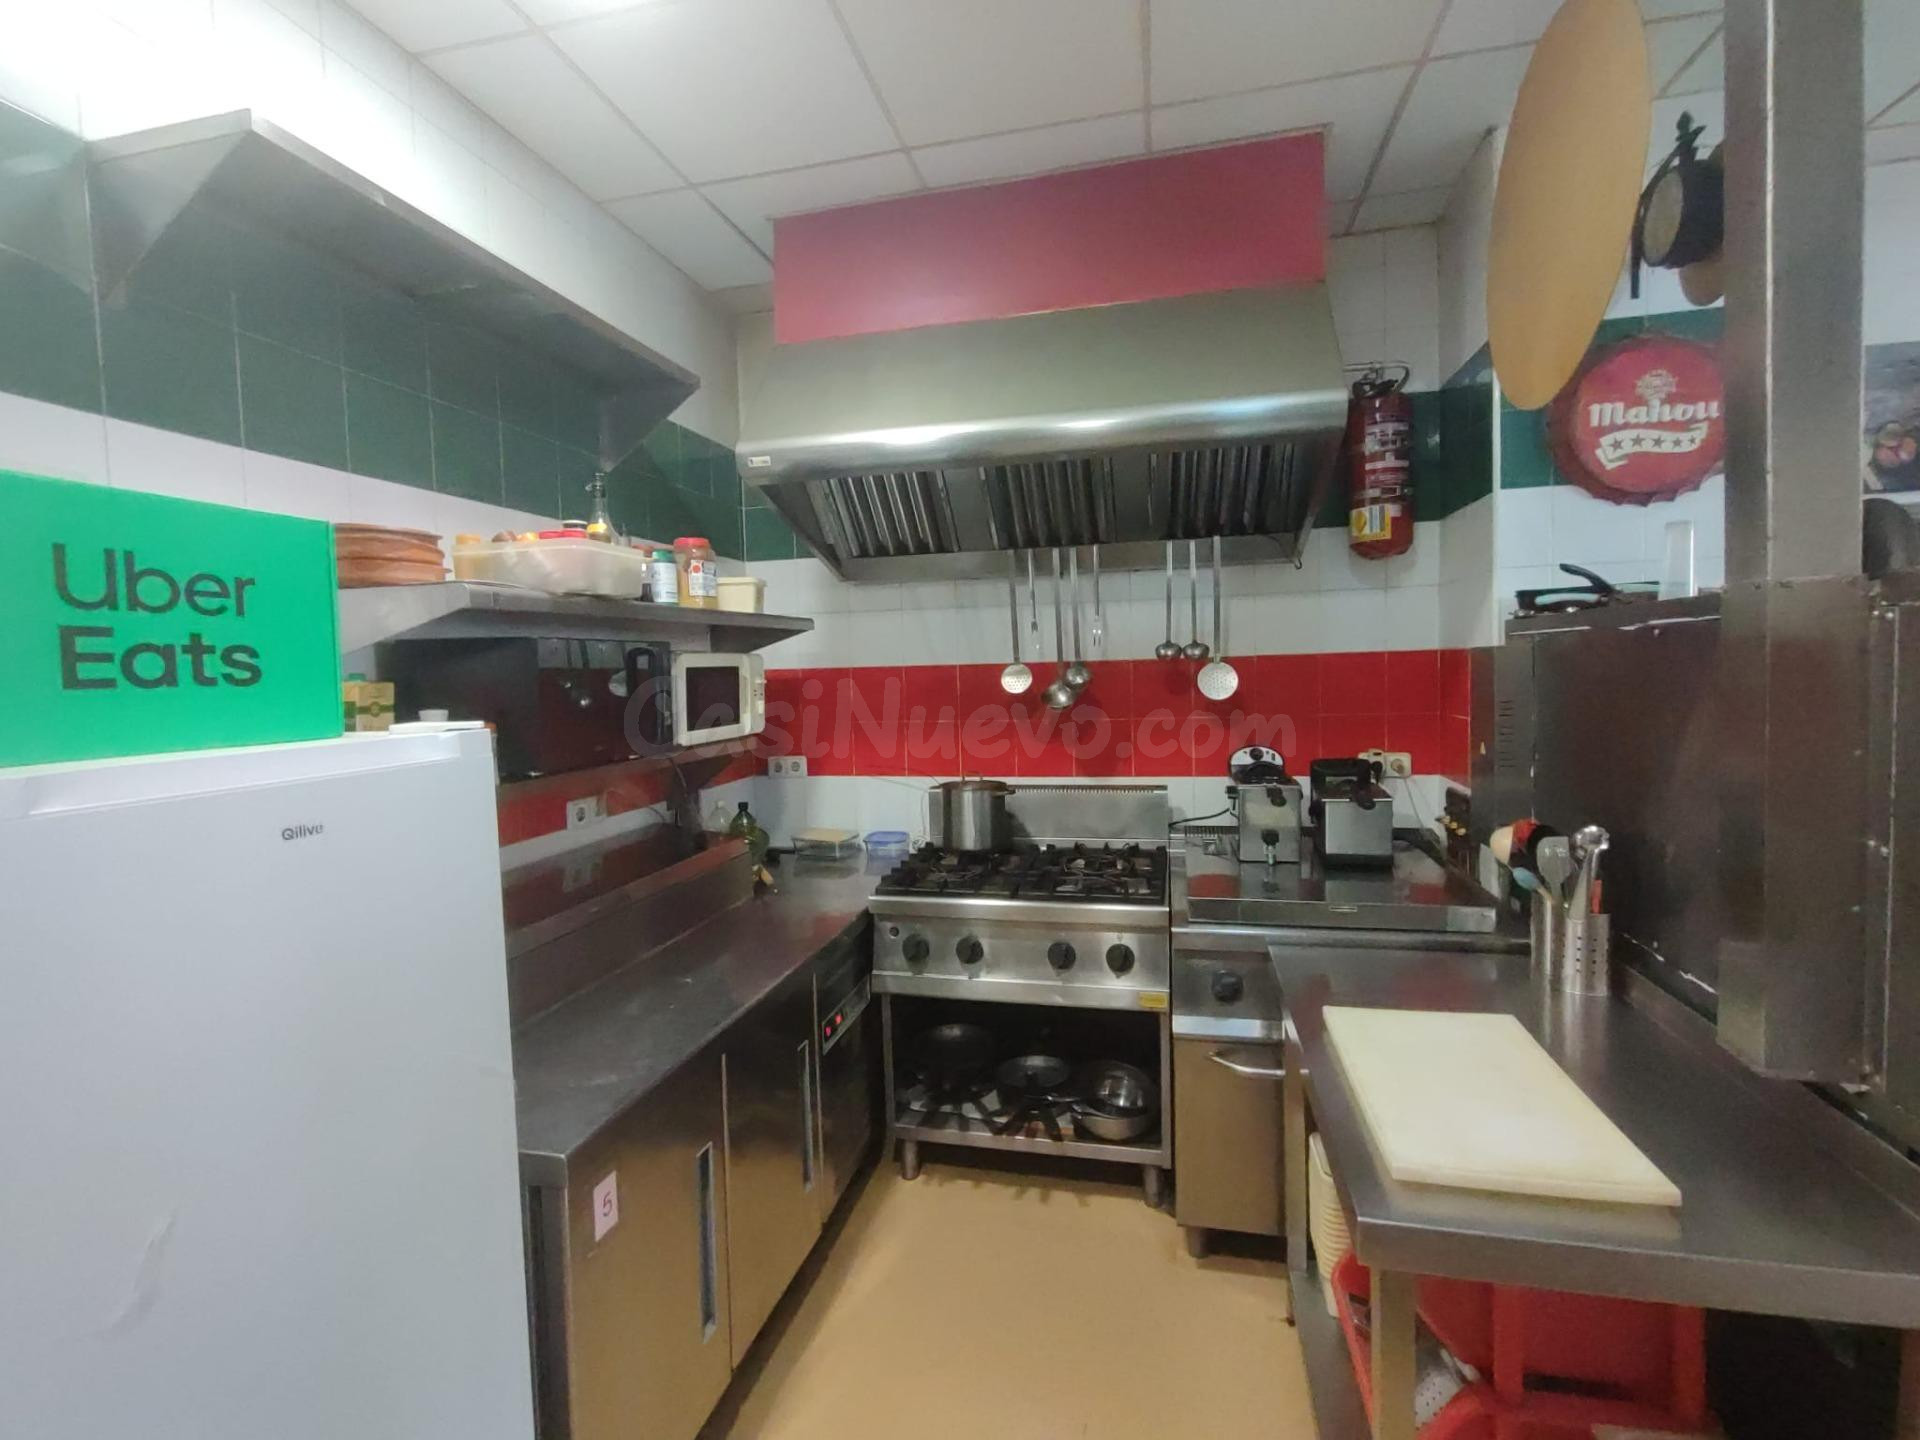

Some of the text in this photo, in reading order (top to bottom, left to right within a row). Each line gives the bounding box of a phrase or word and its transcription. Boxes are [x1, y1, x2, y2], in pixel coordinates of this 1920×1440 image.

[1588, 399, 1720, 427] Mahou
[52, 543, 256, 617] Uber
[58, 624, 262, 690] Eats
